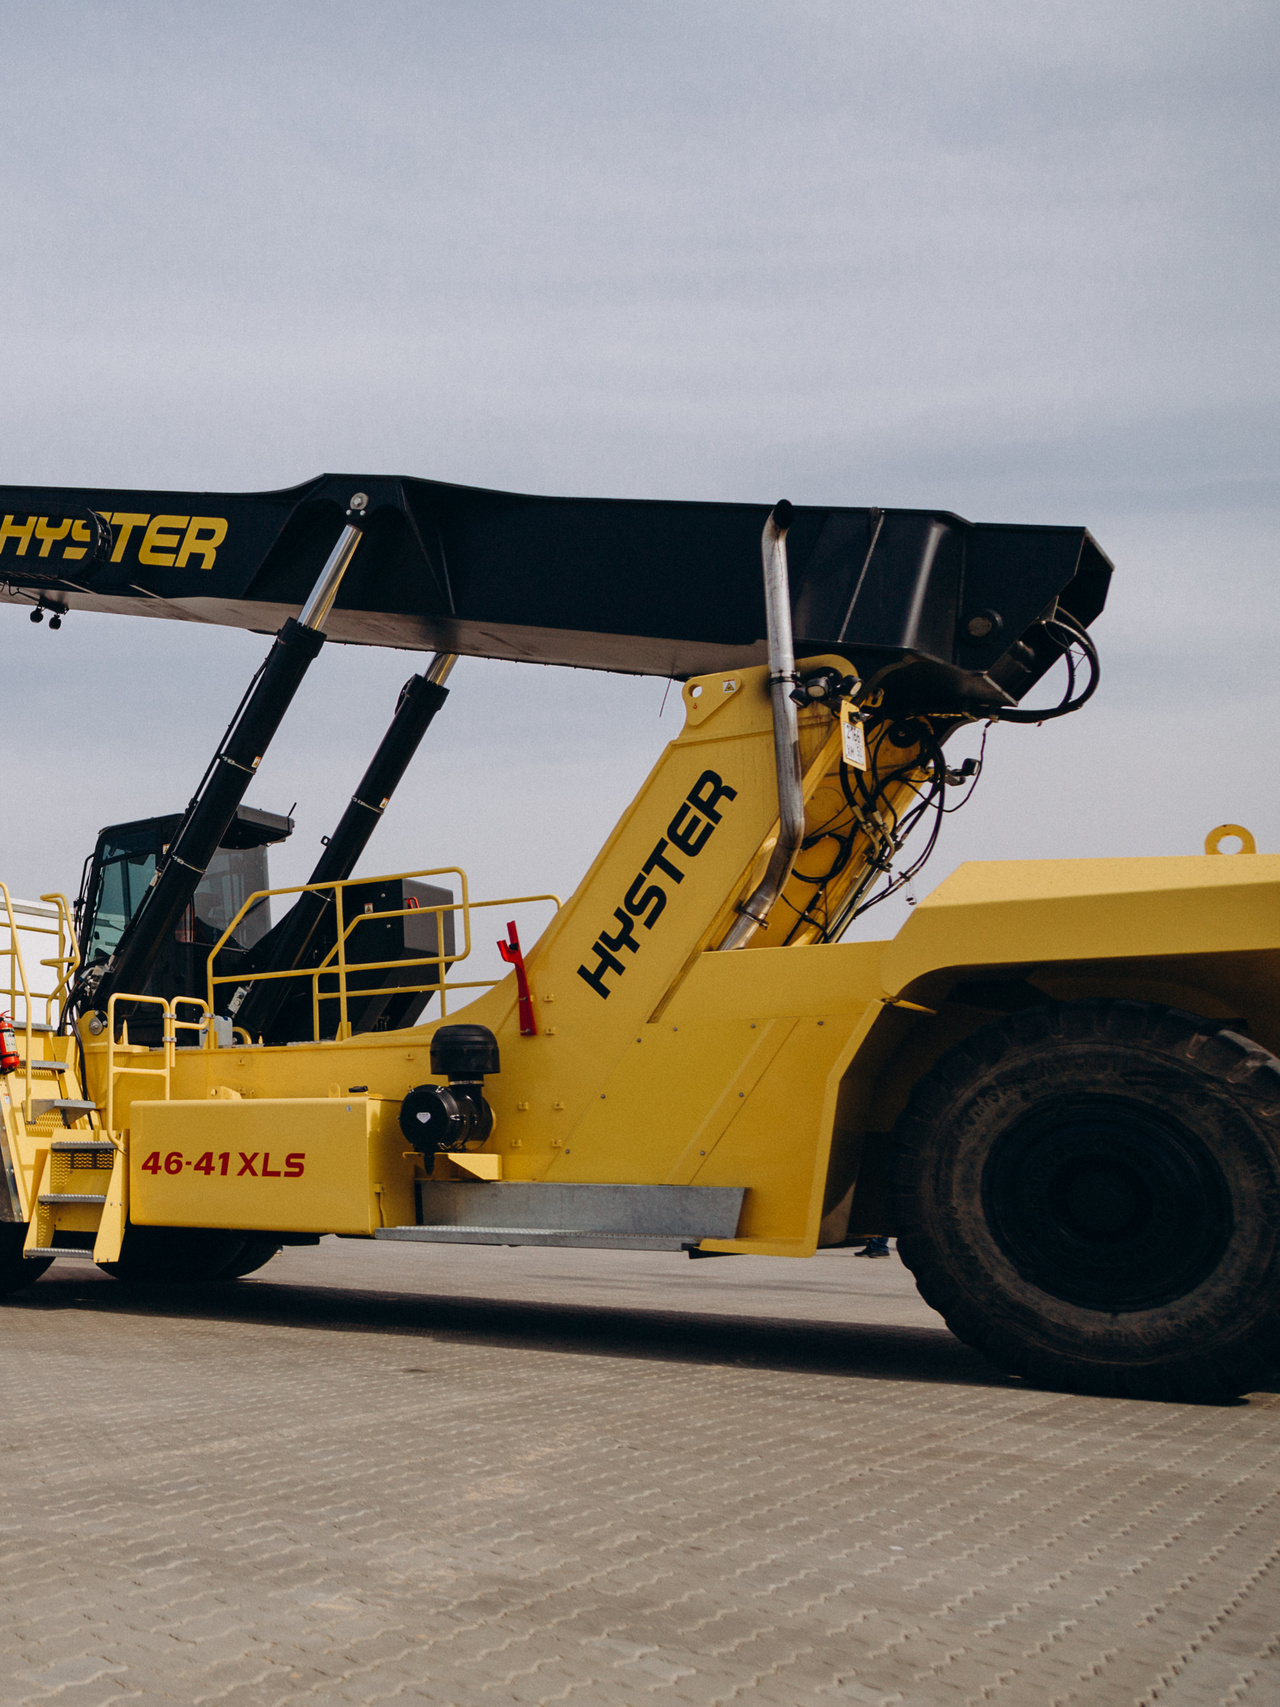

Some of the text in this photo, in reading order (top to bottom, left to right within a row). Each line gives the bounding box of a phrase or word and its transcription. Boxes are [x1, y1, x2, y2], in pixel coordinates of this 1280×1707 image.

[576, 769, 738, 1000] HYSTER
[141, 1151, 307, 1178] 46-41 XLS
